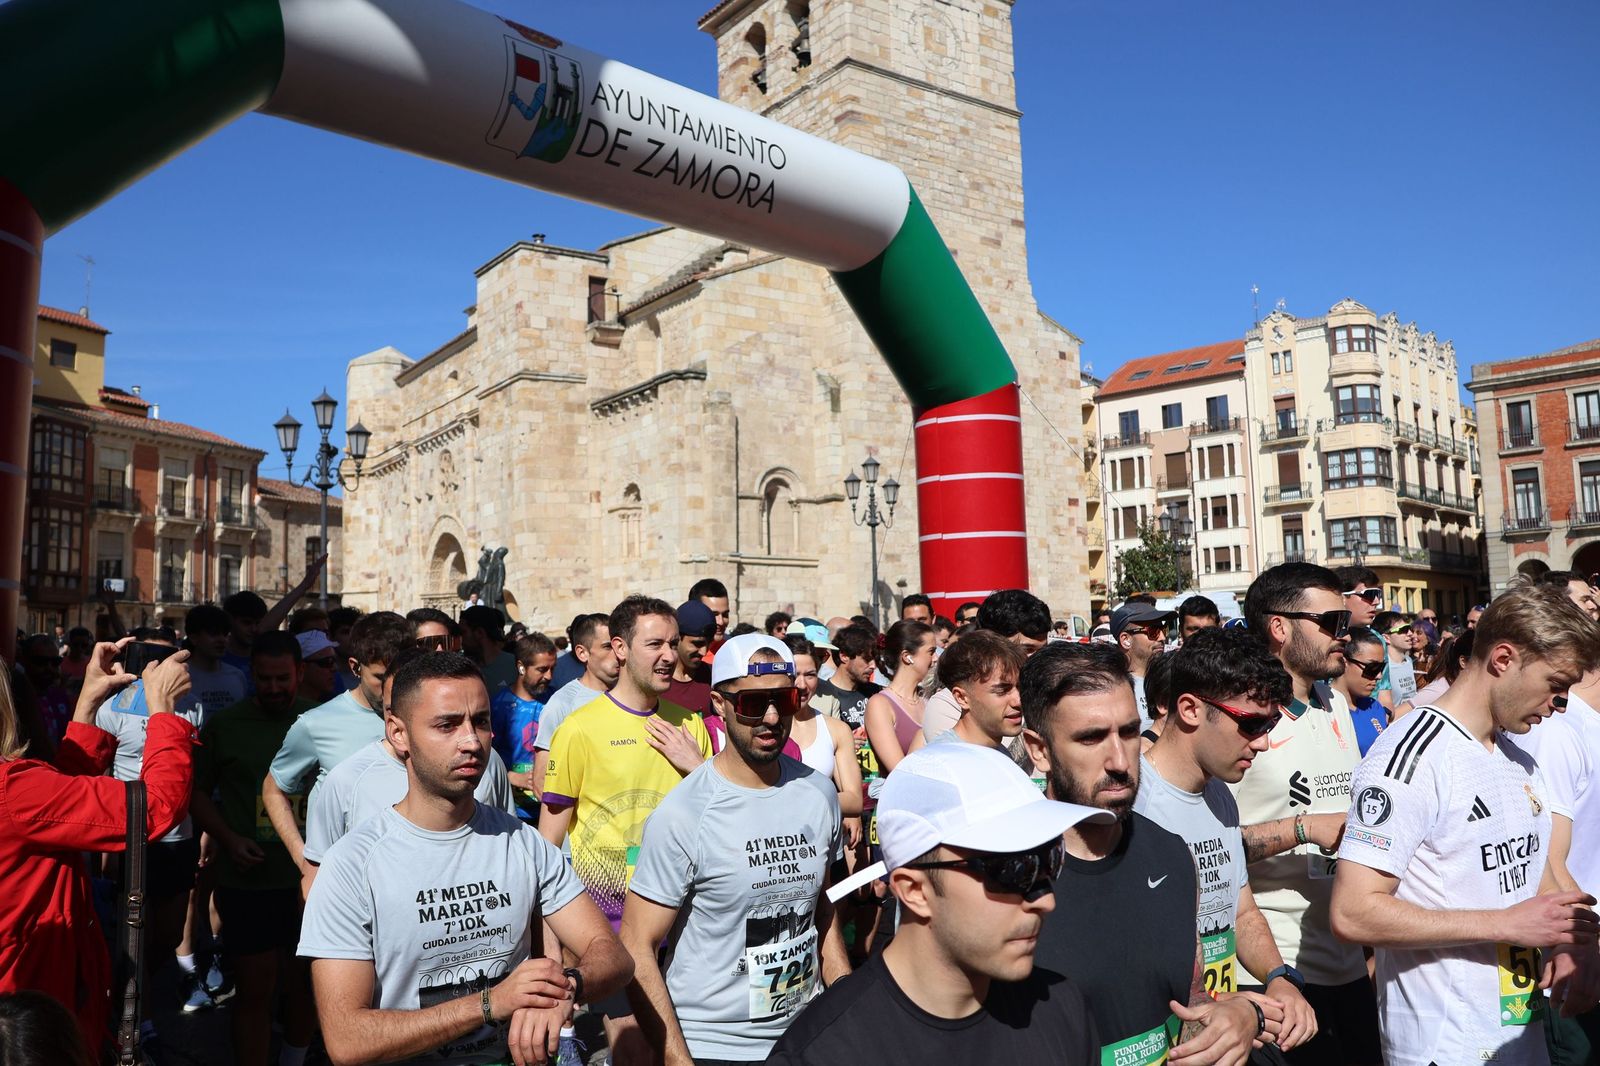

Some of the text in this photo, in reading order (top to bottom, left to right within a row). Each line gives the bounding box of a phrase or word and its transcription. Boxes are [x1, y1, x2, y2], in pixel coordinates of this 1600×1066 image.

[591, 81, 786, 170] AYUNTAMIENTO
[576, 119, 775, 213] DE ZAMORA
[1366, 804, 1377, 815] 15
[764, 833, 808, 850] MEDIA
[1194, 837, 1224, 855] MEDIA
[1199, 850, 1231, 870] RATON
[778, 863, 800, 875] 10K
[1204, 869, 1221, 883] 10K
[751, 878, 777, 890] CIUDAD
[787, 873, 815, 883] ZAMORA
[1211, 881, 1230, 892] ZAMORA
[441, 880, 498, 902] MEDIA
[458, 915, 488, 931] 10K
[422, 937, 457, 950] CIUDAD
[470, 926, 508, 940] ZAMORA
[462, 951, 477, 960] abril
[479, 947, 497, 958] 2026
[754, 951, 777, 965] 10K
[764, 953, 813, 993] 722
[1115, 1040, 1166, 1066] CAJA RURAL
